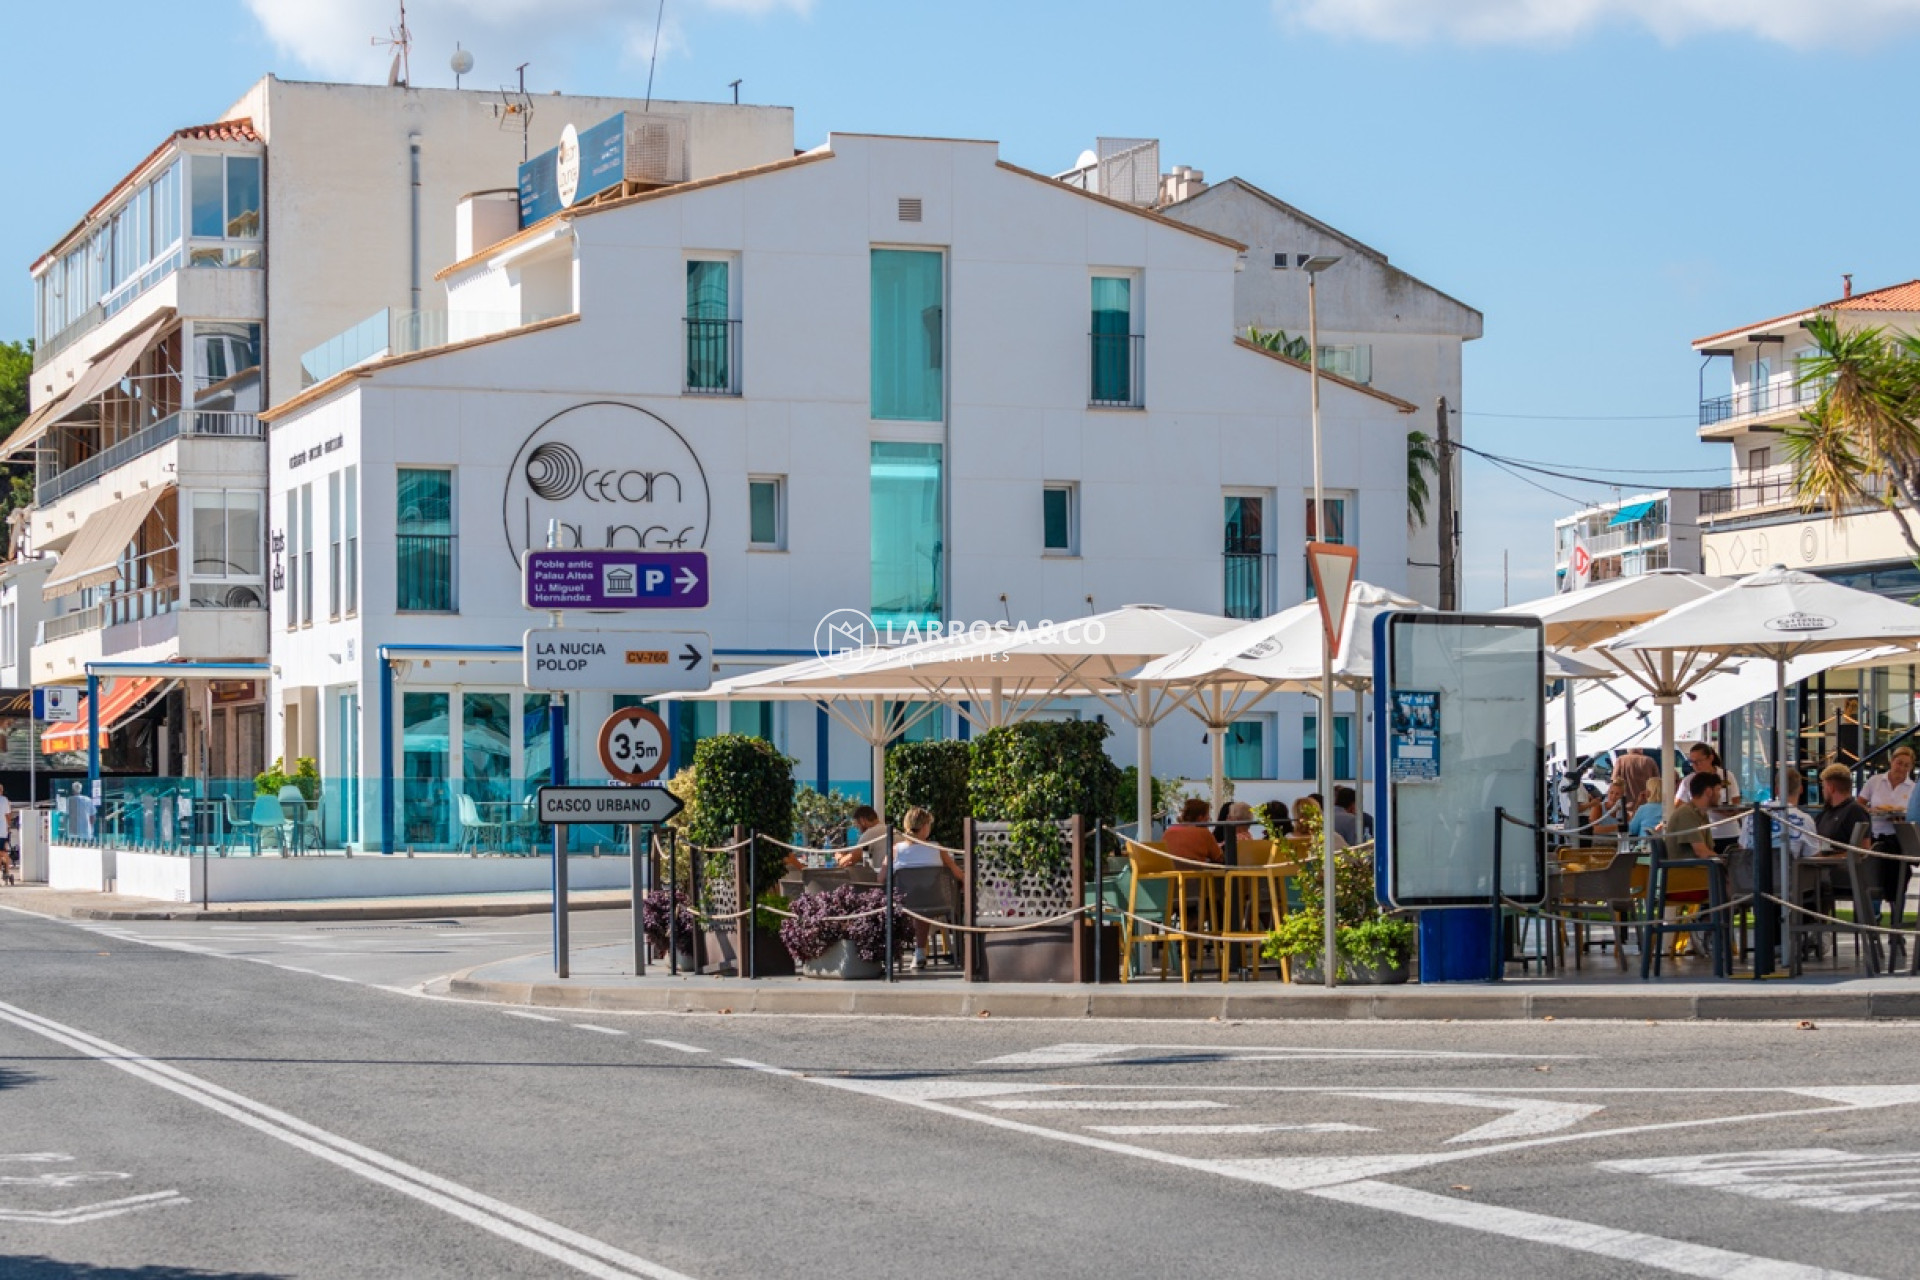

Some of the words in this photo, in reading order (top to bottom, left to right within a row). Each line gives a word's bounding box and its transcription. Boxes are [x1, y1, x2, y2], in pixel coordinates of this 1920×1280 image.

[535, 559, 565, 569] Poble
[567, 559, 593, 569] antic
[535, 571, 565, 580] Palau
[566, 571, 594, 580] Altea
[645, 570, 665, 592] P
[535, 583, 546, 592] U.
[549, 583, 584, 594] Miguel
[535, 592, 592, 602] Hernández
[536, 643, 556, 655] LA
[560, 643, 606, 655] NUCIA
[628, 653, 667, 663] CV-760
[536, 659, 588, 671] POLOP
[547, 798, 591, 812] CASCO
[596, 798, 651, 812] URBANO
